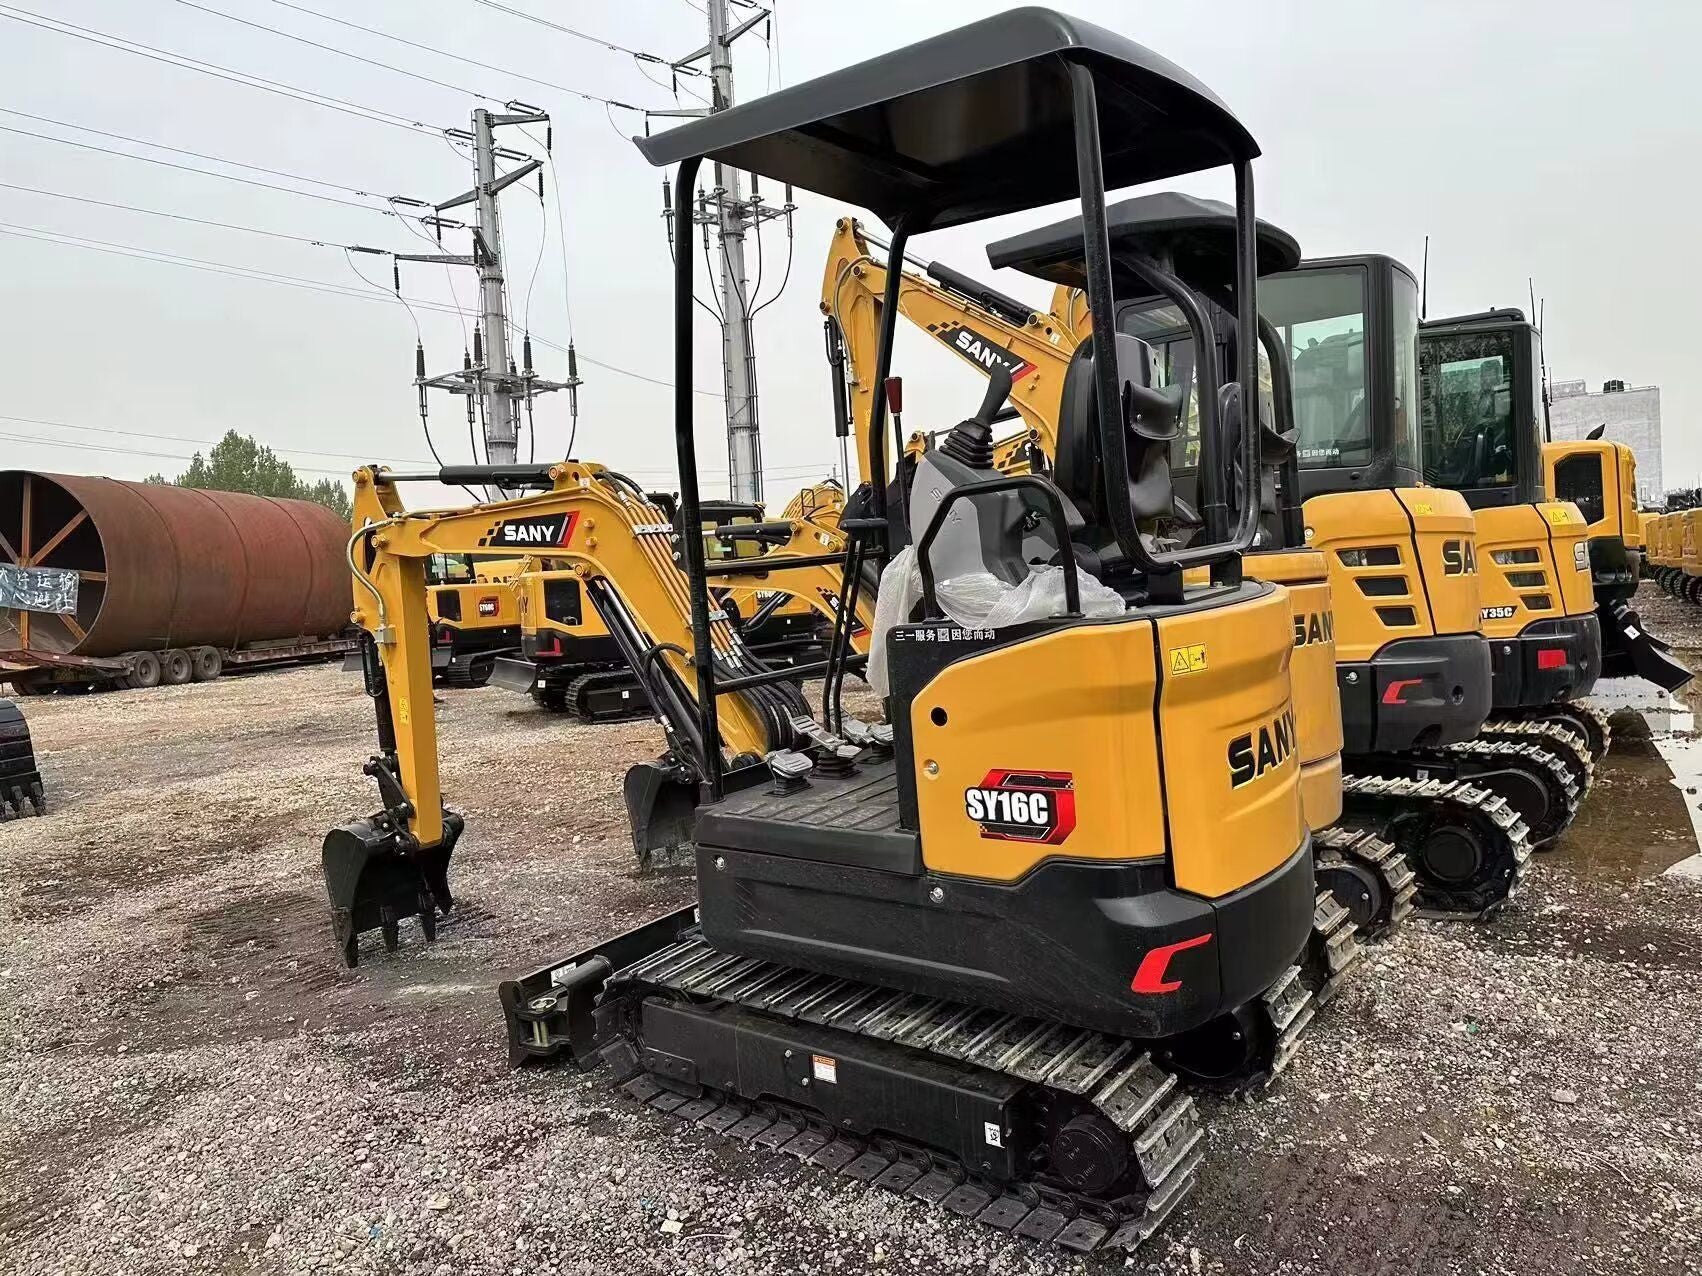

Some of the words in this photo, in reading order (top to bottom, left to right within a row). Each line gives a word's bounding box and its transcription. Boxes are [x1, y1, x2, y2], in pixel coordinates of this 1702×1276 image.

[504, 525, 554, 542] SANY
[1441, 539, 1478, 576] SA
[895, 630, 936, 642] 三一服务
[951, 628, 996, 641] 因您而动
[966, 788, 1049, 825] SY16C
